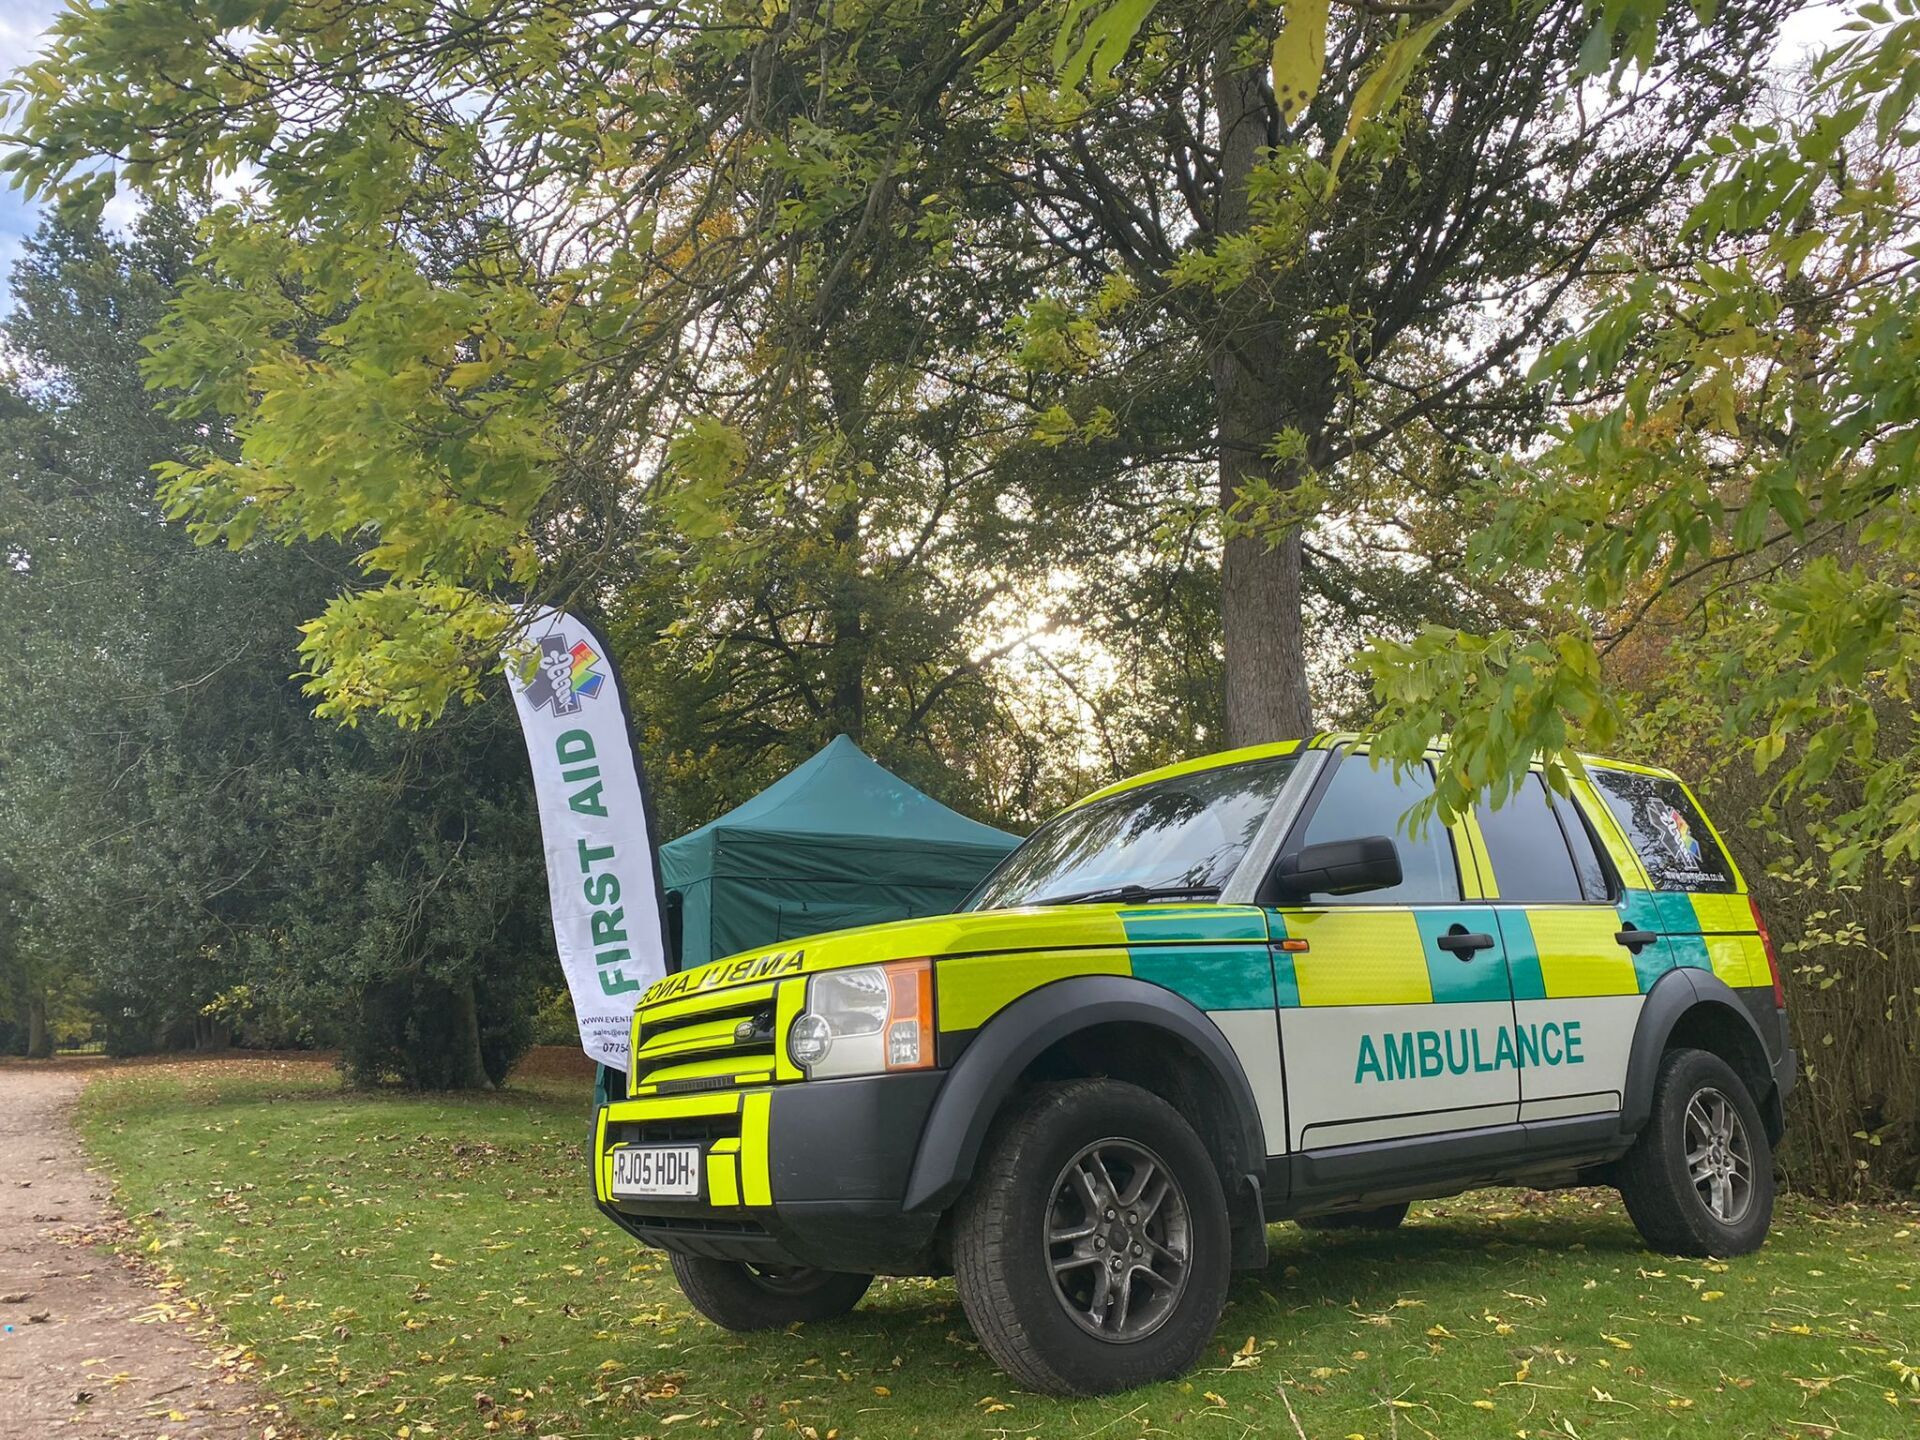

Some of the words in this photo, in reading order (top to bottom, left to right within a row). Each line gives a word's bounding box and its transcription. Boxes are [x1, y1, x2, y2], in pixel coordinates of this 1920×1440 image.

[555, 728, 608, 818] AID
[577, 838, 640, 996] FIRST
[1354, 1021, 1585, 1084] AMBULANCE
[617, 1152, 652, 1185] RJ05
[655, 1151, 689, 1185] HDH
